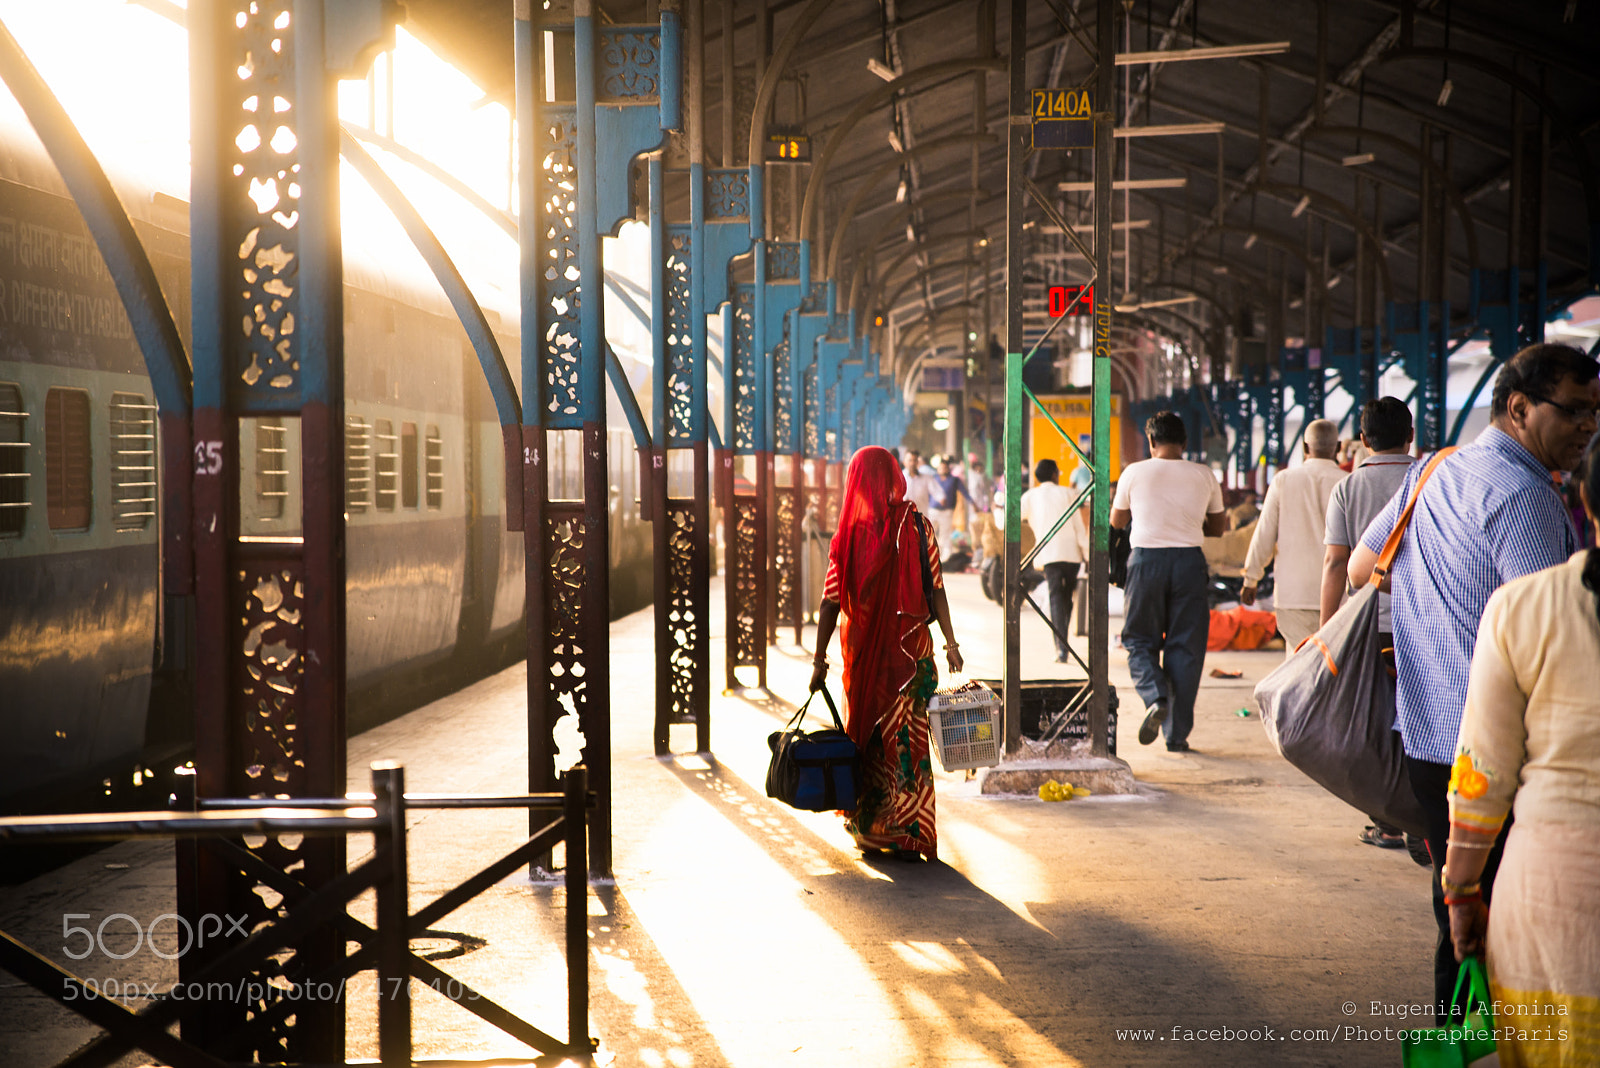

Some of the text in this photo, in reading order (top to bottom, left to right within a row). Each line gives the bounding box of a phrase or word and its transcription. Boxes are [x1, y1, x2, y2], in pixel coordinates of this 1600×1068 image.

[1035, 91, 1092, 117] 2140A
[780, 141, 799, 158] 13
[194, 440, 223, 475] 15
[523, 446, 541, 466] 14
